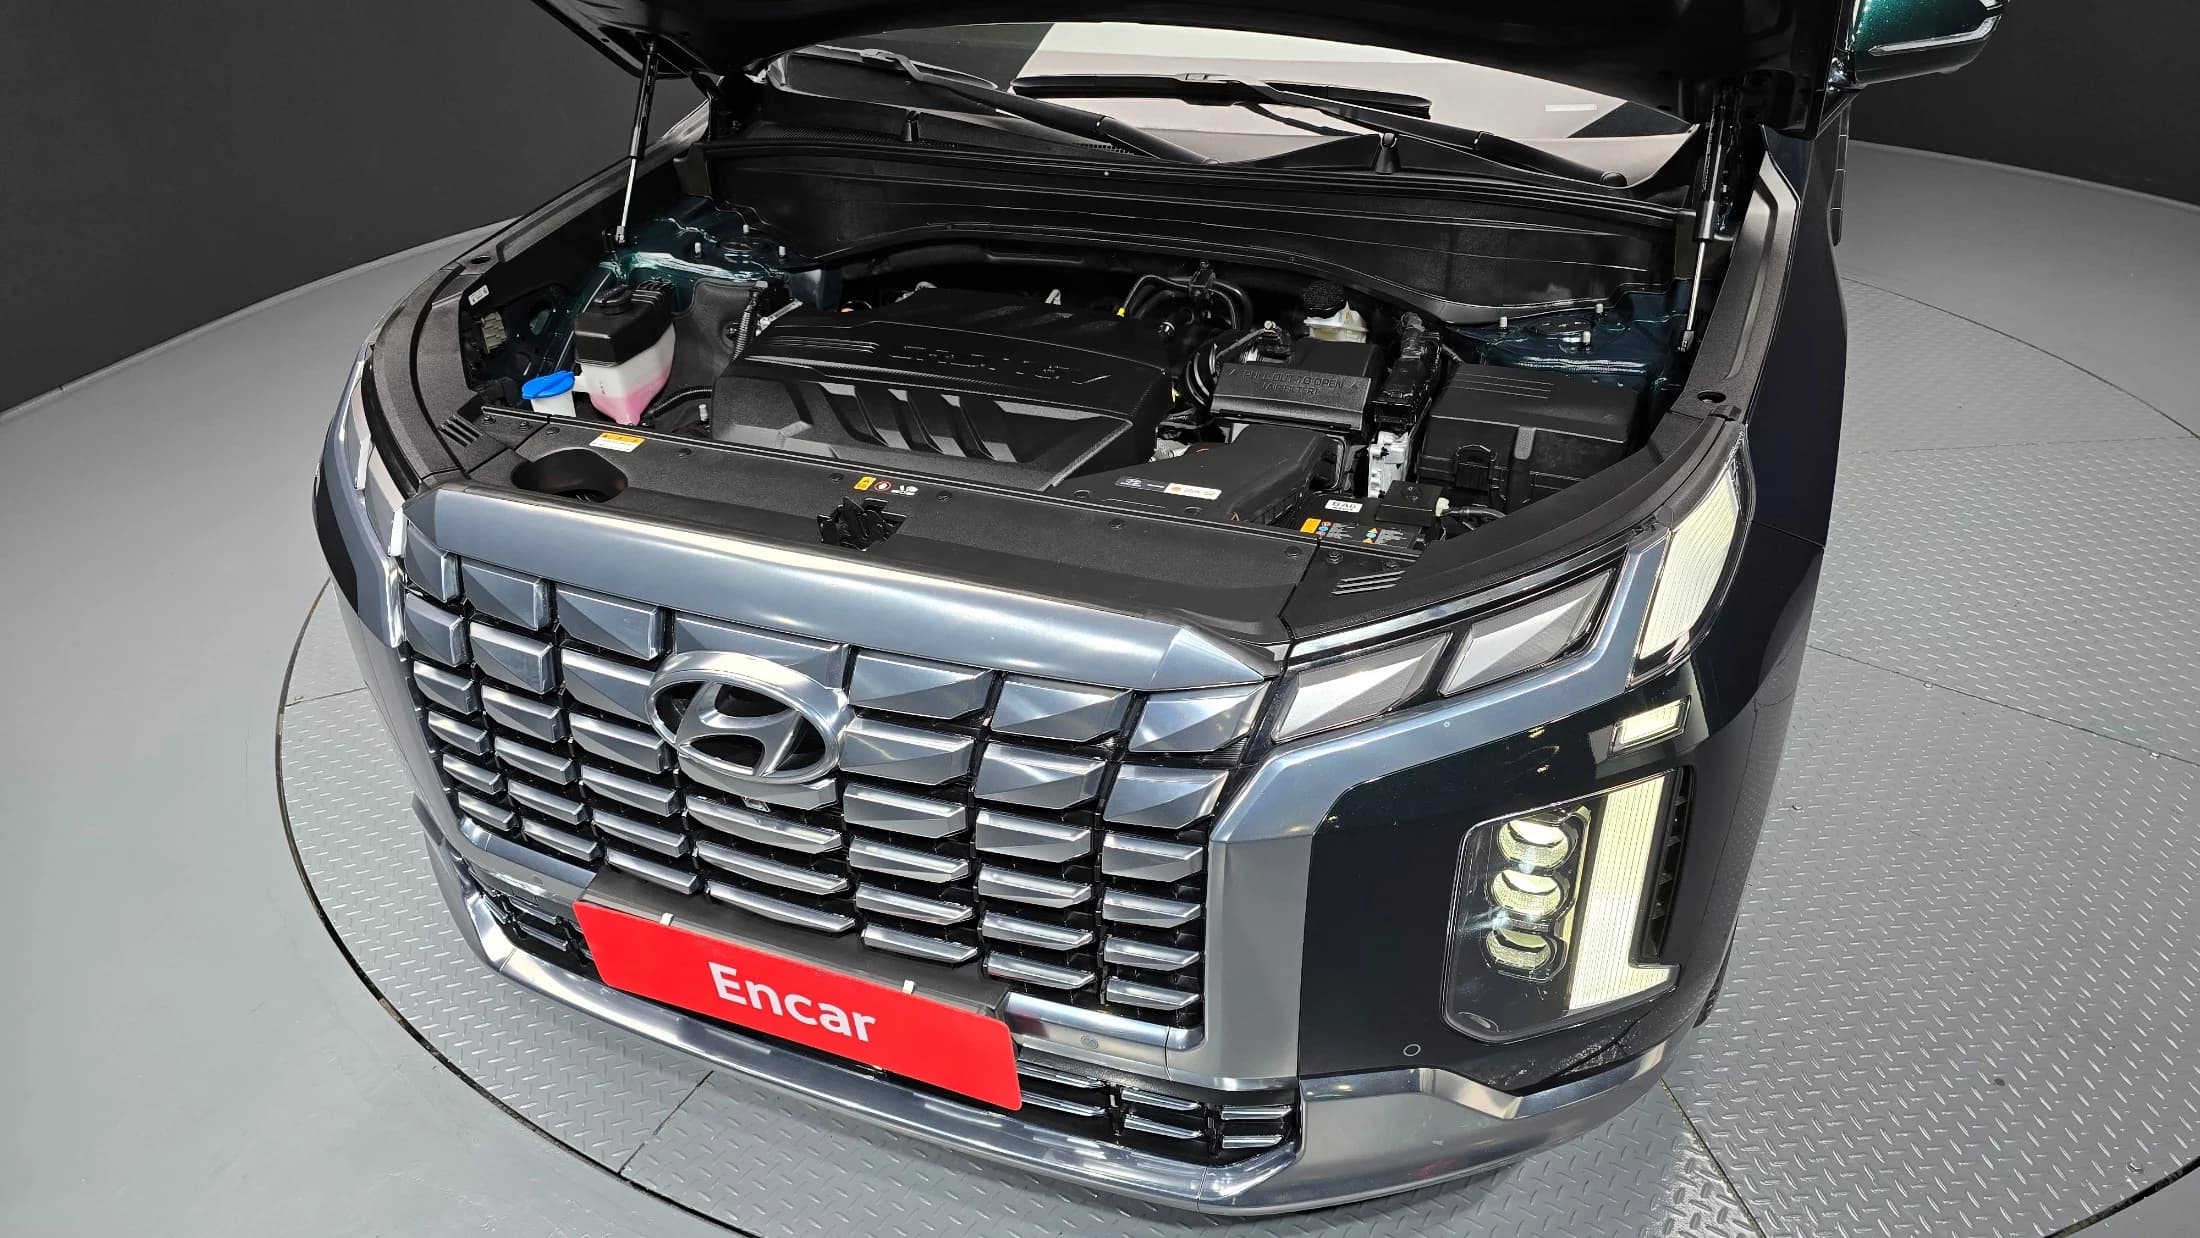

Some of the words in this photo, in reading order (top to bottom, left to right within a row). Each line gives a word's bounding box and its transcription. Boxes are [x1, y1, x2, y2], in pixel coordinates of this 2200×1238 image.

[1271, 372, 1294, 383] OUT
[1313, 376, 1344, 388] OPEN
[708, 961, 876, 1043] Encar
